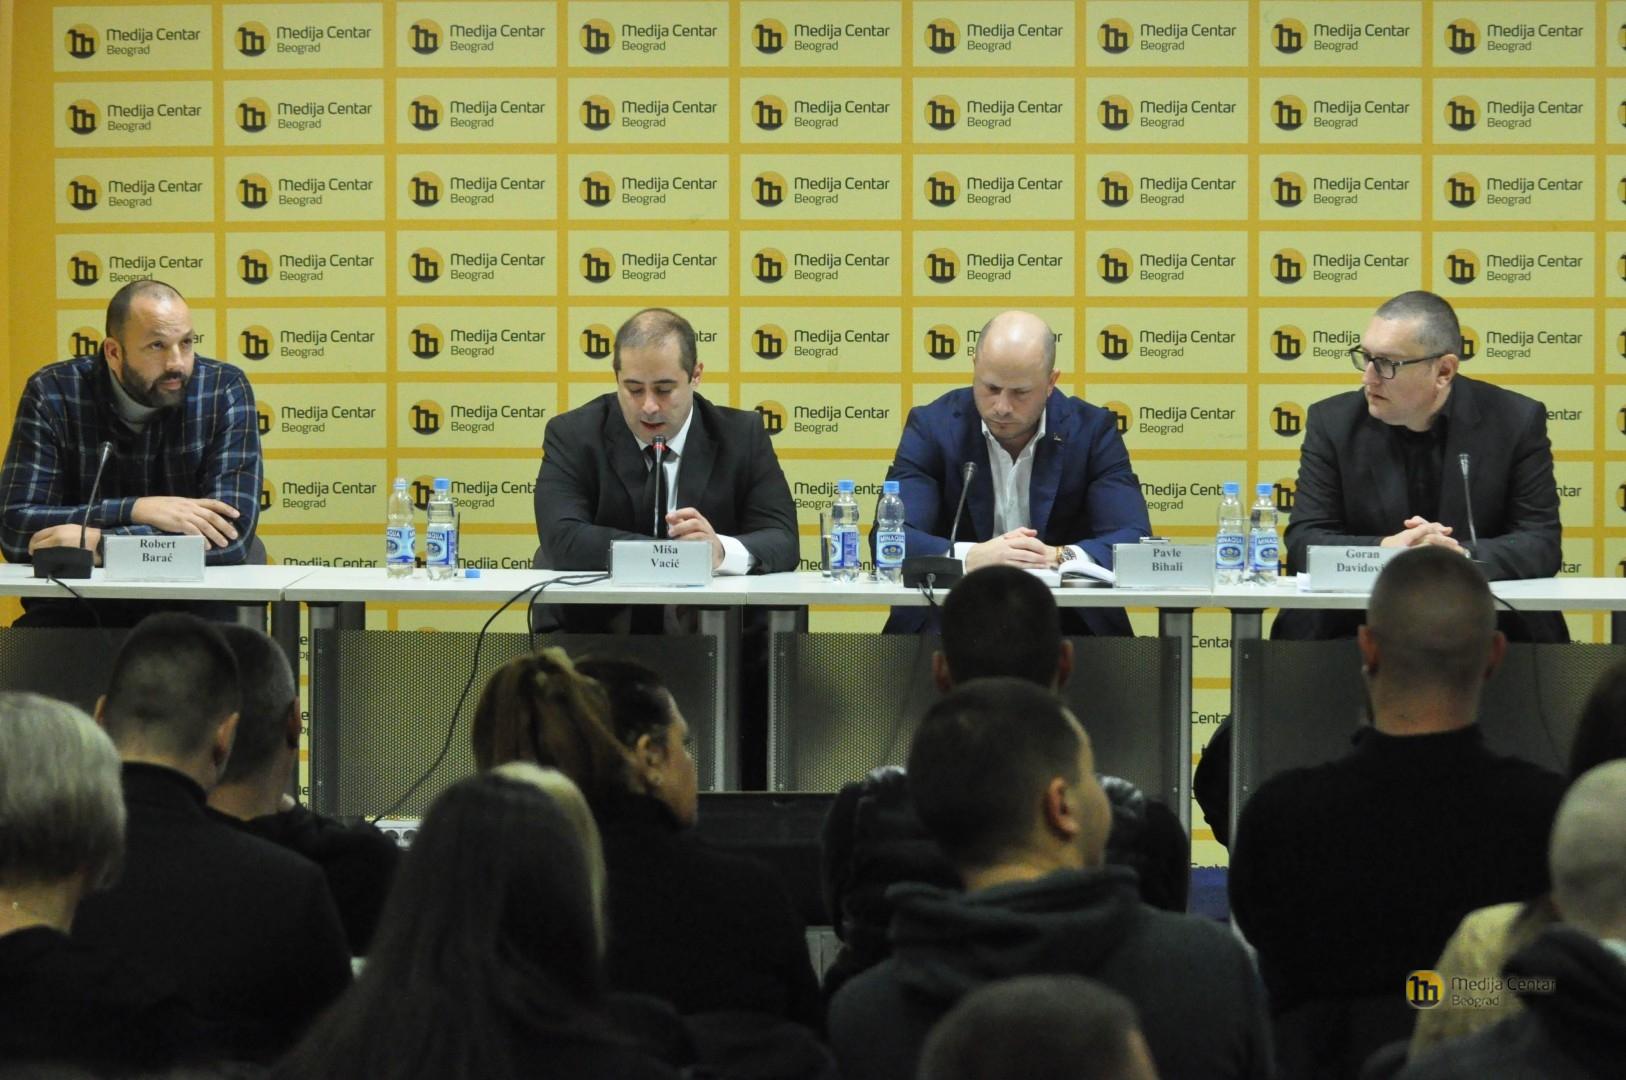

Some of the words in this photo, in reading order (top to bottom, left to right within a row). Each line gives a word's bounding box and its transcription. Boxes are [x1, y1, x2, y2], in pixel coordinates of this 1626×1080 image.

[105, 27, 154, 45] Medija
[155, 27, 201, 41] Centar
[276, 25, 325, 43] Medija
[326, 25, 372, 39] Centar
[449, 24, 498, 41] Medija
[499, 24, 546, 38] Centar
[621, 23, 670, 41] Medija
[671, 23, 718, 38] Centar
[794, 23, 842, 41] Medija
[844, 23, 891, 38] Centar
[966, 23, 1015, 40] Medija
[1017, 23, 1064, 37] Centar
[1140, 23, 1189, 40] Medija
[1191, 23, 1238, 37] Centar
[1313, 23, 1362, 41] Medija
[1364, 23, 1411, 38] Centar
[1486, 23, 1536, 41] Medija
[1537, 23, 1584, 38] Centar
[106, 44, 151, 58] Beograd
[276, 42, 321, 55] Beograd
[449, 40, 495, 54] Beograd
[621, 40, 666, 54] Beograd
[794, 39, 839, 53] Beograd
[967, 39, 1012, 54] Beograd
[1140, 39, 1185, 53] Beograd
[1313, 39, 1359, 53] Beograd
[1487, 40, 1532, 54] Beograd
[106, 103, 155, 121] Medija
[156, 103, 202, 117] Centar
[277, 101, 325, 119] Medija
[327, 101, 373, 116] Centar
[449, 100, 498, 117] Medija
[500, 100, 546, 114] Centar
[621, 99, 670, 117] Medija
[671, 100, 718, 114] Centar
[794, 99, 842, 117] Medija
[844, 100, 891, 114] Centar
[966, 99, 1015, 117] Medija
[1017, 99, 1064, 114] Centar
[1140, 99, 1189, 117] Medija
[1190, 99, 1237, 114] Centar
[1313, 99, 1362, 117] Medija
[1364, 100, 1411, 114] Centar
[1486, 100, 1536, 118] Medija
[1537, 100, 1584, 115] Centar
[107, 119, 152, 134] Beograd
[277, 118, 322, 132] Beograd
[449, 116, 495, 130] Beograd
[621, 116, 667, 130] Beograd
[794, 116, 839, 130] Beograd
[967, 116, 1012, 130] Beograd
[1140, 116, 1185, 130] Beograd
[1313, 116, 1359, 130] Beograd
[1487, 117, 1532, 130] Beograd
[107, 179, 156, 196] Medija
[157, 179, 204, 193] Centar
[278, 177, 326, 195] Medija
[328, 177, 374, 191] Centar
[449, 176, 498, 193] Medija
[500, 176, 546, 191] Centar
[621, 176, 670, 193] Medija
[672, 176, 718, 191] Centar
[794, 176, 842, 194] Medija
[844, 176, 891, 191] Centar
[966, 176, 1015, 194] Medija
[1017, 176, 1064, 191] Centar
[1139, 176, 1188, 193] Medija
[1190, 176, 1237, 191] Centar
[1313, 176, 1362, 194] Medija
[1363, 177, 1411, 191] Centar
[1486, 177, 1536, 194] Medija
[1537, 177, 1584, 191] Centar
[108, 196, 153, 209] Beograd
[278, 194, 323, 208] Beograd
[450, 193, 495, 206] Beograd
[621, 192, 667, 206] Beograd
[794, 192, 839, 206] Beograd
[966, 193, 1012, 207] Beograd
[1140, 193, 1185, 207] Beograd
[1313, 193, 1358, 207] Beograd
[1486, 193, 1532, 207] Beograd
[108, 255, 157, 272] Medija
[158, 255, 204, 269] Centar
[279, 253, 327, 271] Medija
[329, 253, 375, 268] Centar
[450, 252, 498, 270] Medija
[500, 252, 546, 267] Centar
[621, 252, 670, 270] Medija
[672, 252, 718, 267] Centar
[793, 252, 842, 270] Medija
[844, 253, 891, 267] Centar
[966, 252, 1015, 270] Medija
[1017, 253, 1064, 267] Centar
[1139, 253, 1188, 270] Medija
[1190, 253, 1237, 267] Centar
[1312, 253, 1361, 271] Medija
[1363, 253, 1410, 268] Centar
[1486, 254, 1535, 271] Medija
[1537, 254, 1584, 268] Centar
[279, 270, 324, 284] Beograd
[450, 269, 495, 282] Beograd
[621, 269, 667, 283] Beograd
[794, 269, 839, 283] Beograd
[966, 269, 1012, 283] Beograd
[1139, 269, 1185, 283] Beograd
[1313, 270, 1358, 284] Beograd
[1486, 270, 1532, 284] Beograd
[280, 329, 328, 347] Medija
[330, 329, 376, 343] Centar
[450, 328, 498, 346] Medija
[500, 328, 547, 343] Centar
[793, 329, 842, 346] Medija
[844, 329, 891, 344] Centar
[1139, 329, 1188, 347] Medija
[1190, 329, 1237, 344] Centar
[1312, 330, 1361, 347] Medija
[1486, 330, 1535, 348] Medija
[1536, 330, 1584, 345] Centar
[280, 346, 325, 359] Beograd
[450, 345, 495, 359] Beograd
[794, 345, 839, 359] Beograd
[1139, 346, 1185, 360] Beograd
[1486, 347, 1532, 361] Beograd
[281, 405, 329, 423] Medija
[331, 405, 377, 419] Centar
[450, 404, 498, 422] Medija
[500, 404, 547, 419] Centar
[793, 405, 842, 422] Medija
[844, 405, 891, 420] Centar
[1139, 406, 1188, 423] Medija
[1189, 406, 1237, 420] Centar
[281, 422, 326, 435] Beograd
[450, 421, 495, 434] Beograd
[793, 421, 839, 435] Beograd
[1139, 422, 1184, 436] Beograd
[282, 481, 330, 498] Medija
[331, 481, 377, 495] Centar
[139, 538, 176, 549] Robert
[652, 544, 679, 555] Miša
[141, 552, 174, 563] Barać
[1152, 548, 1182, 558] Pavle
[1345, 548, 1380, 559] Goran
[1151, 562, 1184, 572] Bihali
